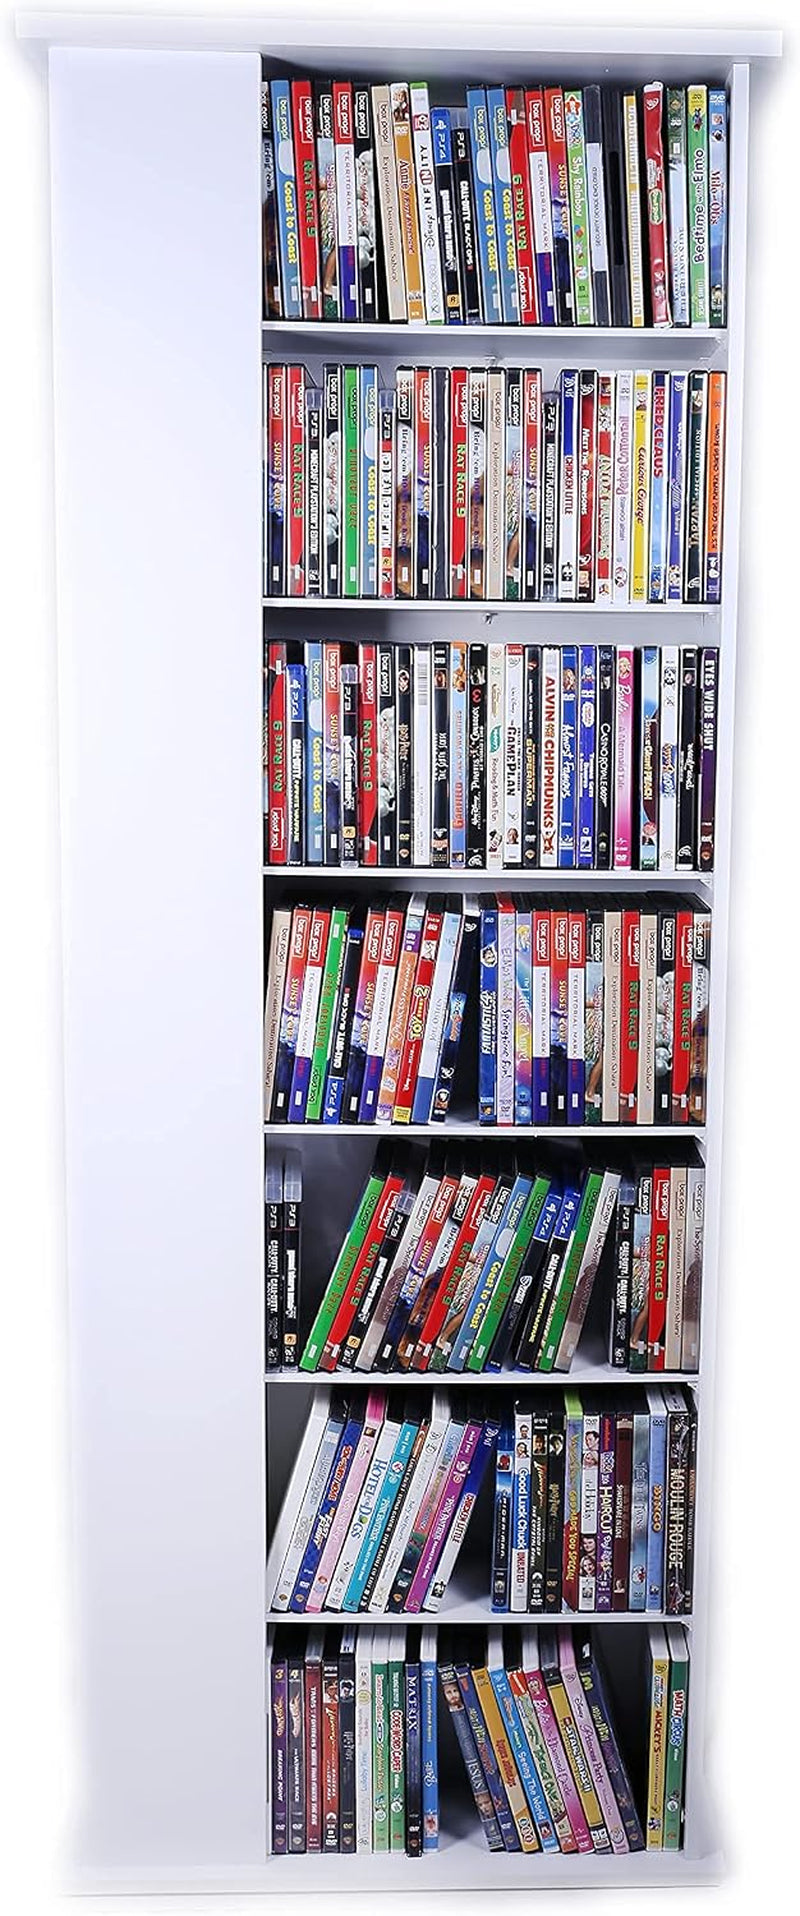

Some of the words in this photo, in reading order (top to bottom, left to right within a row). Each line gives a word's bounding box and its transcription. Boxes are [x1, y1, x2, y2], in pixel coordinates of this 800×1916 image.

[398, 160, 411, 190] Annie
[571, 157, 582, 176] Shy
[691, 148, 705, 183] Elmo
[284, 181, 295, 212] Coast
[574, 179, 584, 217] Rainbow
[286, 216, 295, 228] to
[693, 205, 706, 263] Bedtime
[288, 232, 297, 264] Coast
[654, 387, 665, 424] FRED
[654, 430, 663, 478] CLAUS
[705, 660, 715, 686] EYES
[545, 677, 555, 723] ALVIN
[704, 690, 714, 719] WIDE
[703, 723, 713, 751] SHUT
[544, 740, 555, 828] CHIPMUNKS
[486, 1260, 501, 1289] Coast
[480, 1289, 491, 1301] to
[367, 1458, 388, 1497] HOTEL
[518, 1468, 529, 1495] Good
[518, 1495, 528, 1519] Luck
[669, 1468, 685, 1520] MOULIN
[599, 1486, 613, 1535] HAIRCUT
[516, 1520, 527, 1549] Chuck
[668, 1524, 684, 1570] ROUGE
[518, 1751, 531, 1779] Seeing
[526, 1780, 537, 1795] The
[530, 1796, 546, 1820] World
